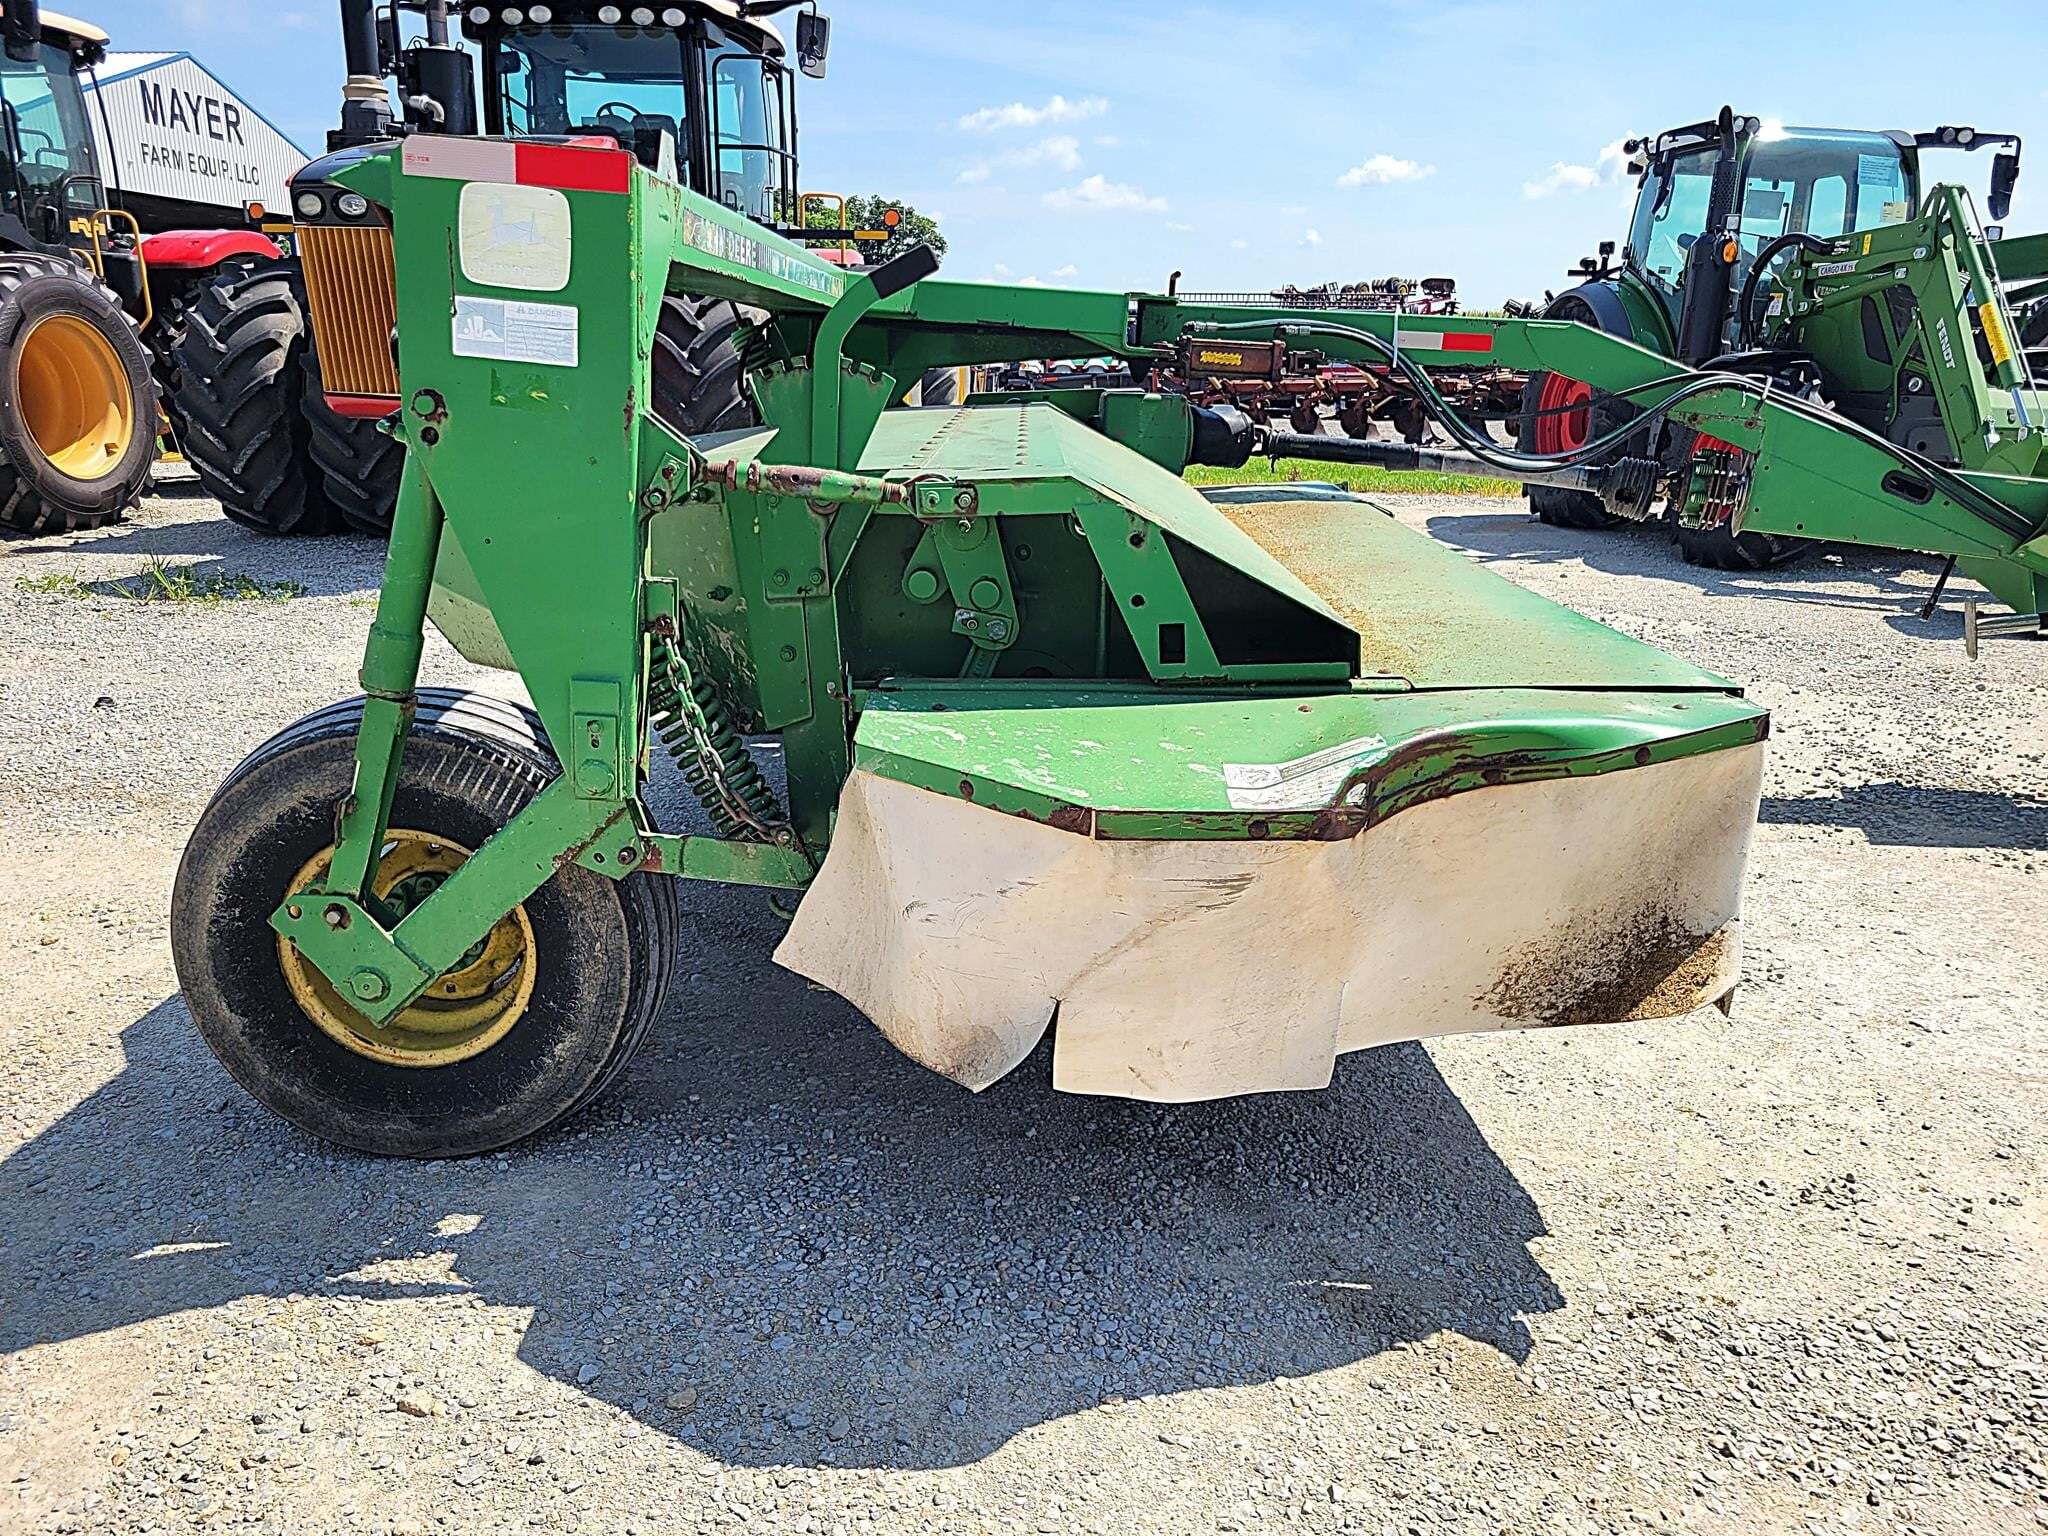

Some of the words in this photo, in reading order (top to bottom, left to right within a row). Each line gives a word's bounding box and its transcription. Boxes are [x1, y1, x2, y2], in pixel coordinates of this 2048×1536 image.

[139, 79, 244, 146] MAYER
[141, 142, 184, 172] FARM
[187, 152, 234, 181] EQUIP.
[235, 163, 260, 186] LLC
[1820, 265, 1840, 275] CARGO
[1936, 317, 1956, 369] FENDT
